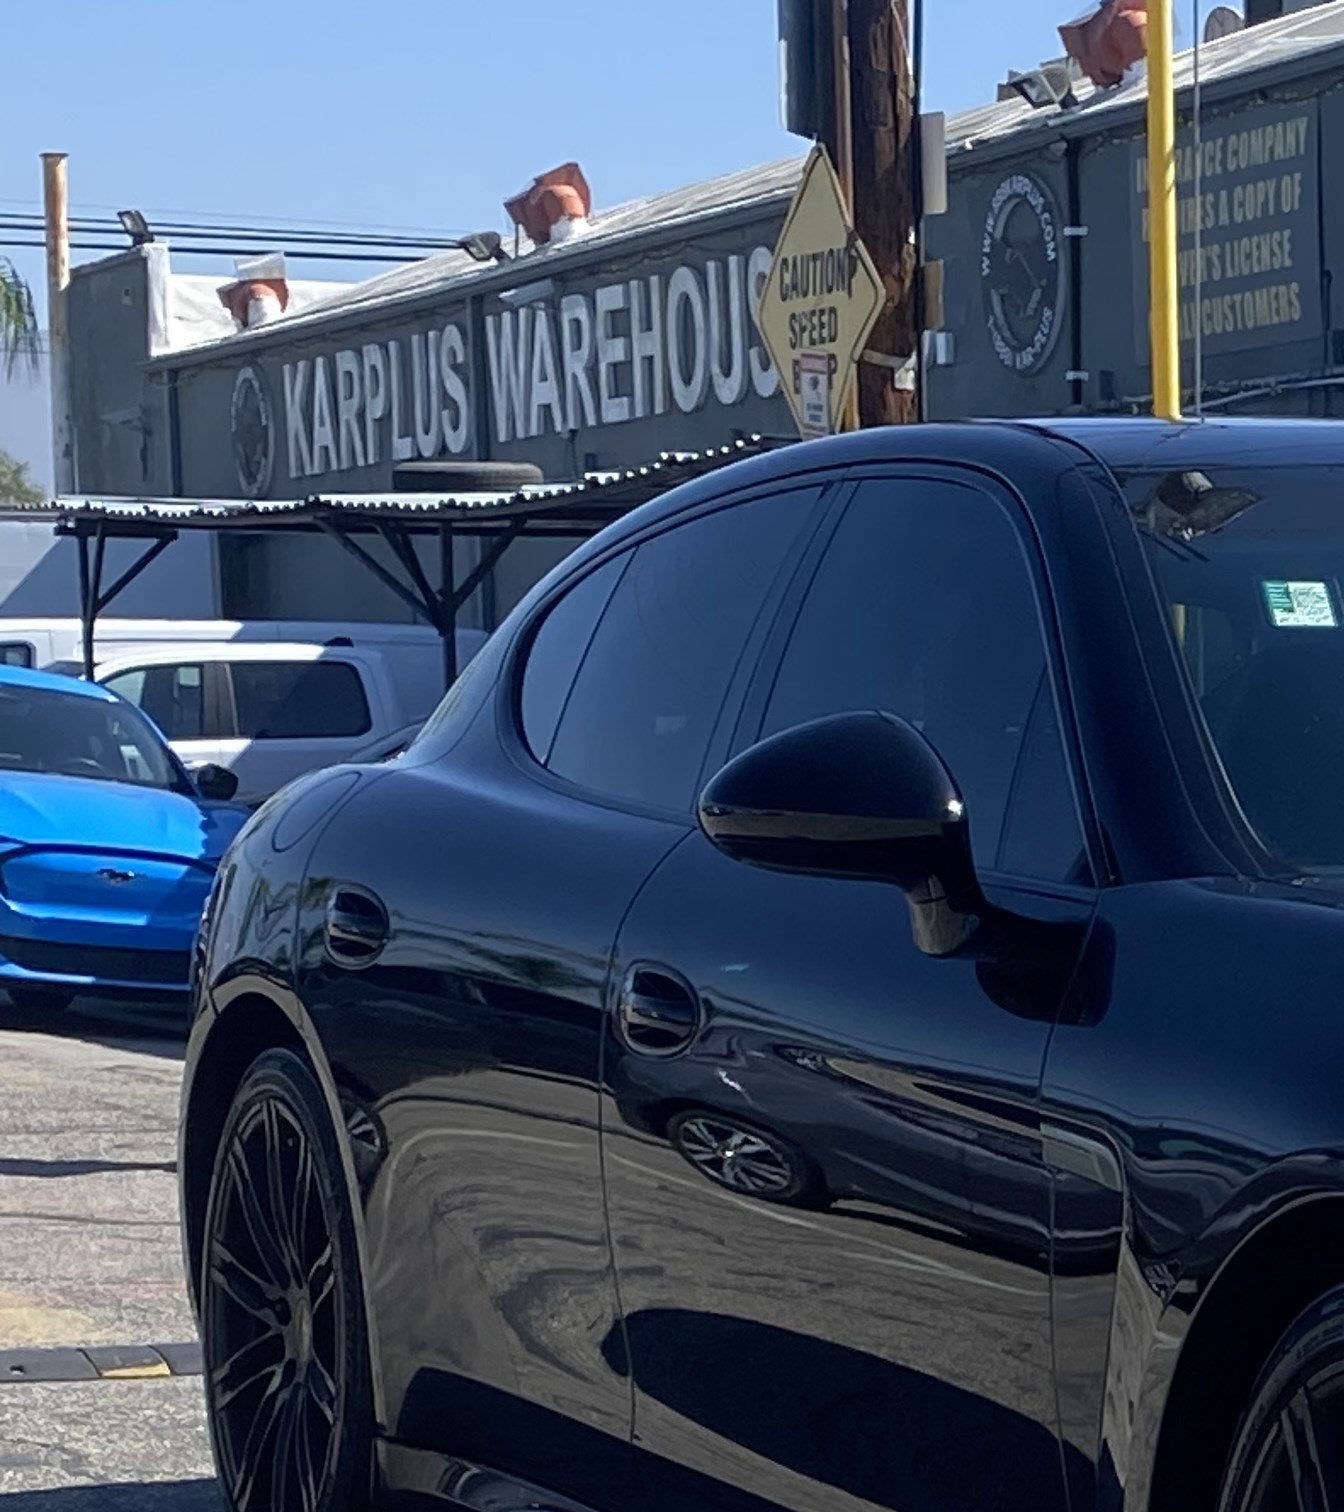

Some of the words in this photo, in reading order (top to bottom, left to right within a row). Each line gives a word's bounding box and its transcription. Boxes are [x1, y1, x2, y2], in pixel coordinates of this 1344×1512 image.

[1227, 117, 1309, 172] COMPANY
[1218, 190, 1230, 226] A
[1233, 178, 1278, 224] COPY
[1281, 172, 1302, 214] OF
[1225, 229, 1293, 279] LICENSE
[789, 306, 838, 350] SPEED
[1203, 282, 1302, 336] CUSTOMERS
[283, 324, 469, 478] KARPLUS
[486, 246, 781, 442] WAREHOUS
